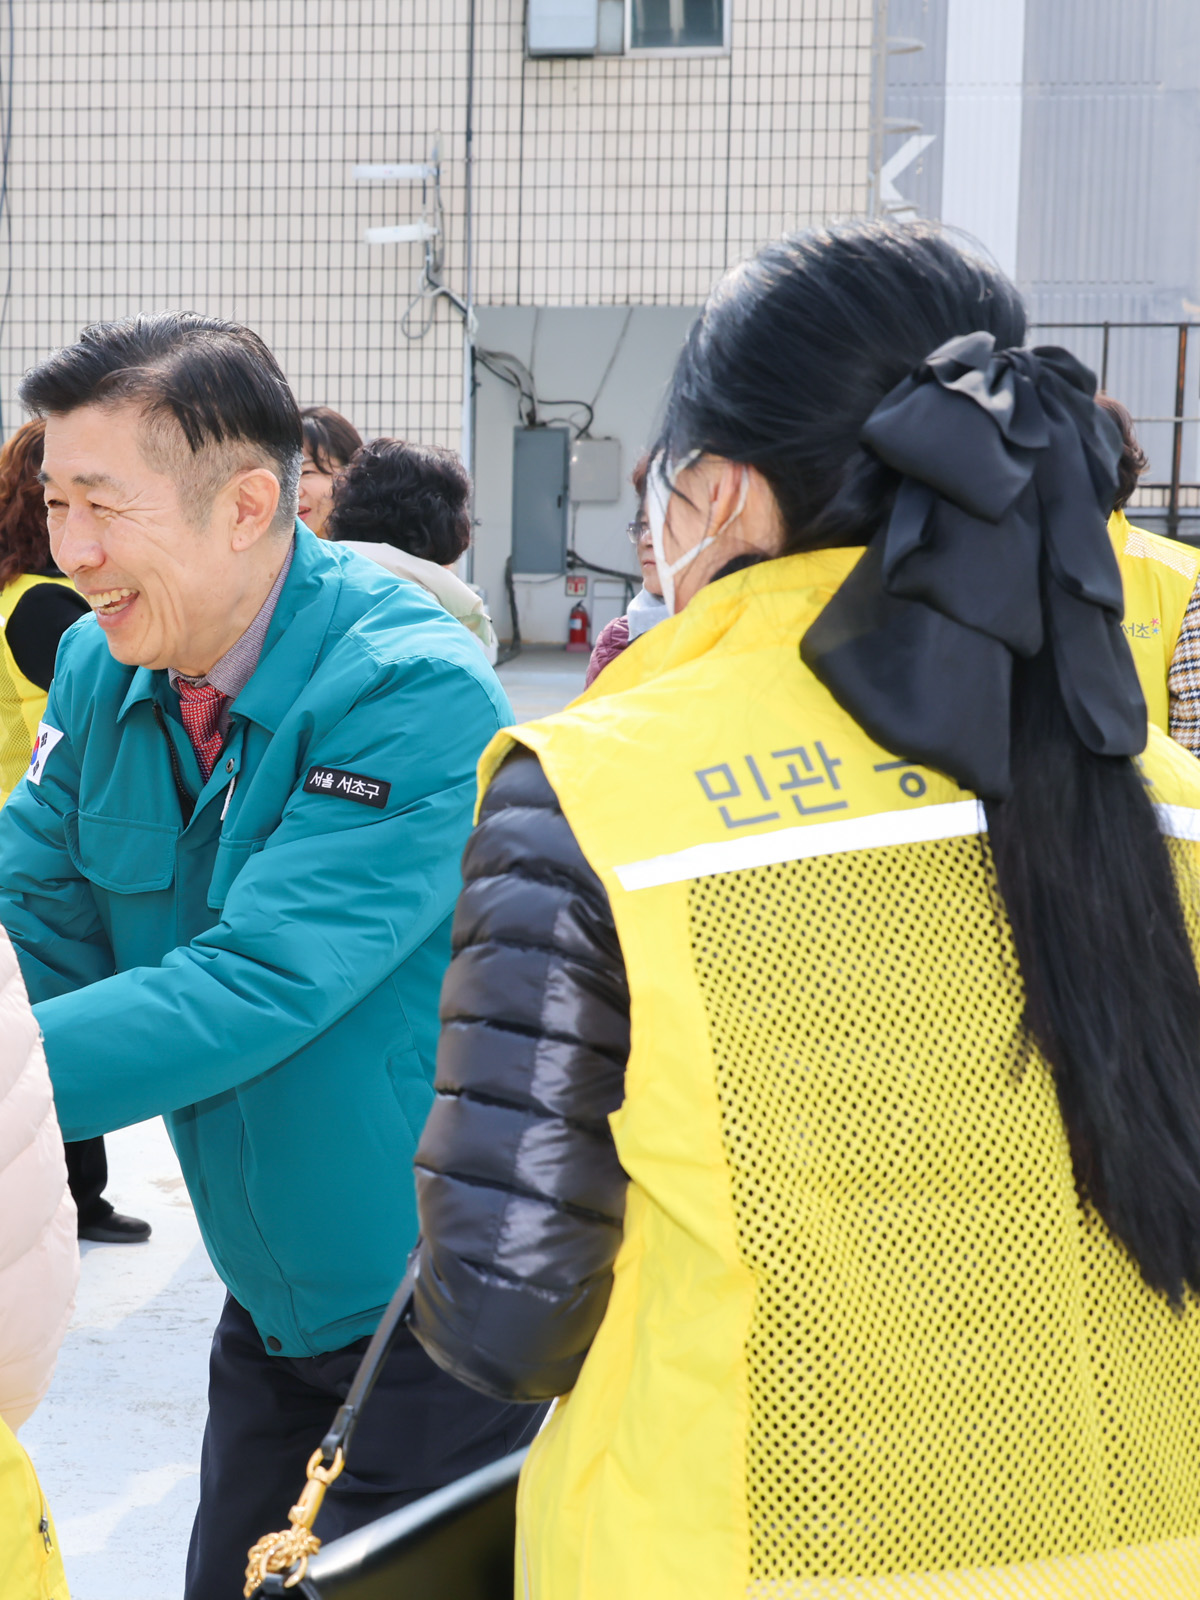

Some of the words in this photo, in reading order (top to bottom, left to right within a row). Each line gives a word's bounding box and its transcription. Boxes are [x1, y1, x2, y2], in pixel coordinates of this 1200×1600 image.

[309, 771, 335, 789] 서울
[336, 776, 380, 800] 서초구
[694, 740, 848, 829] 민관
